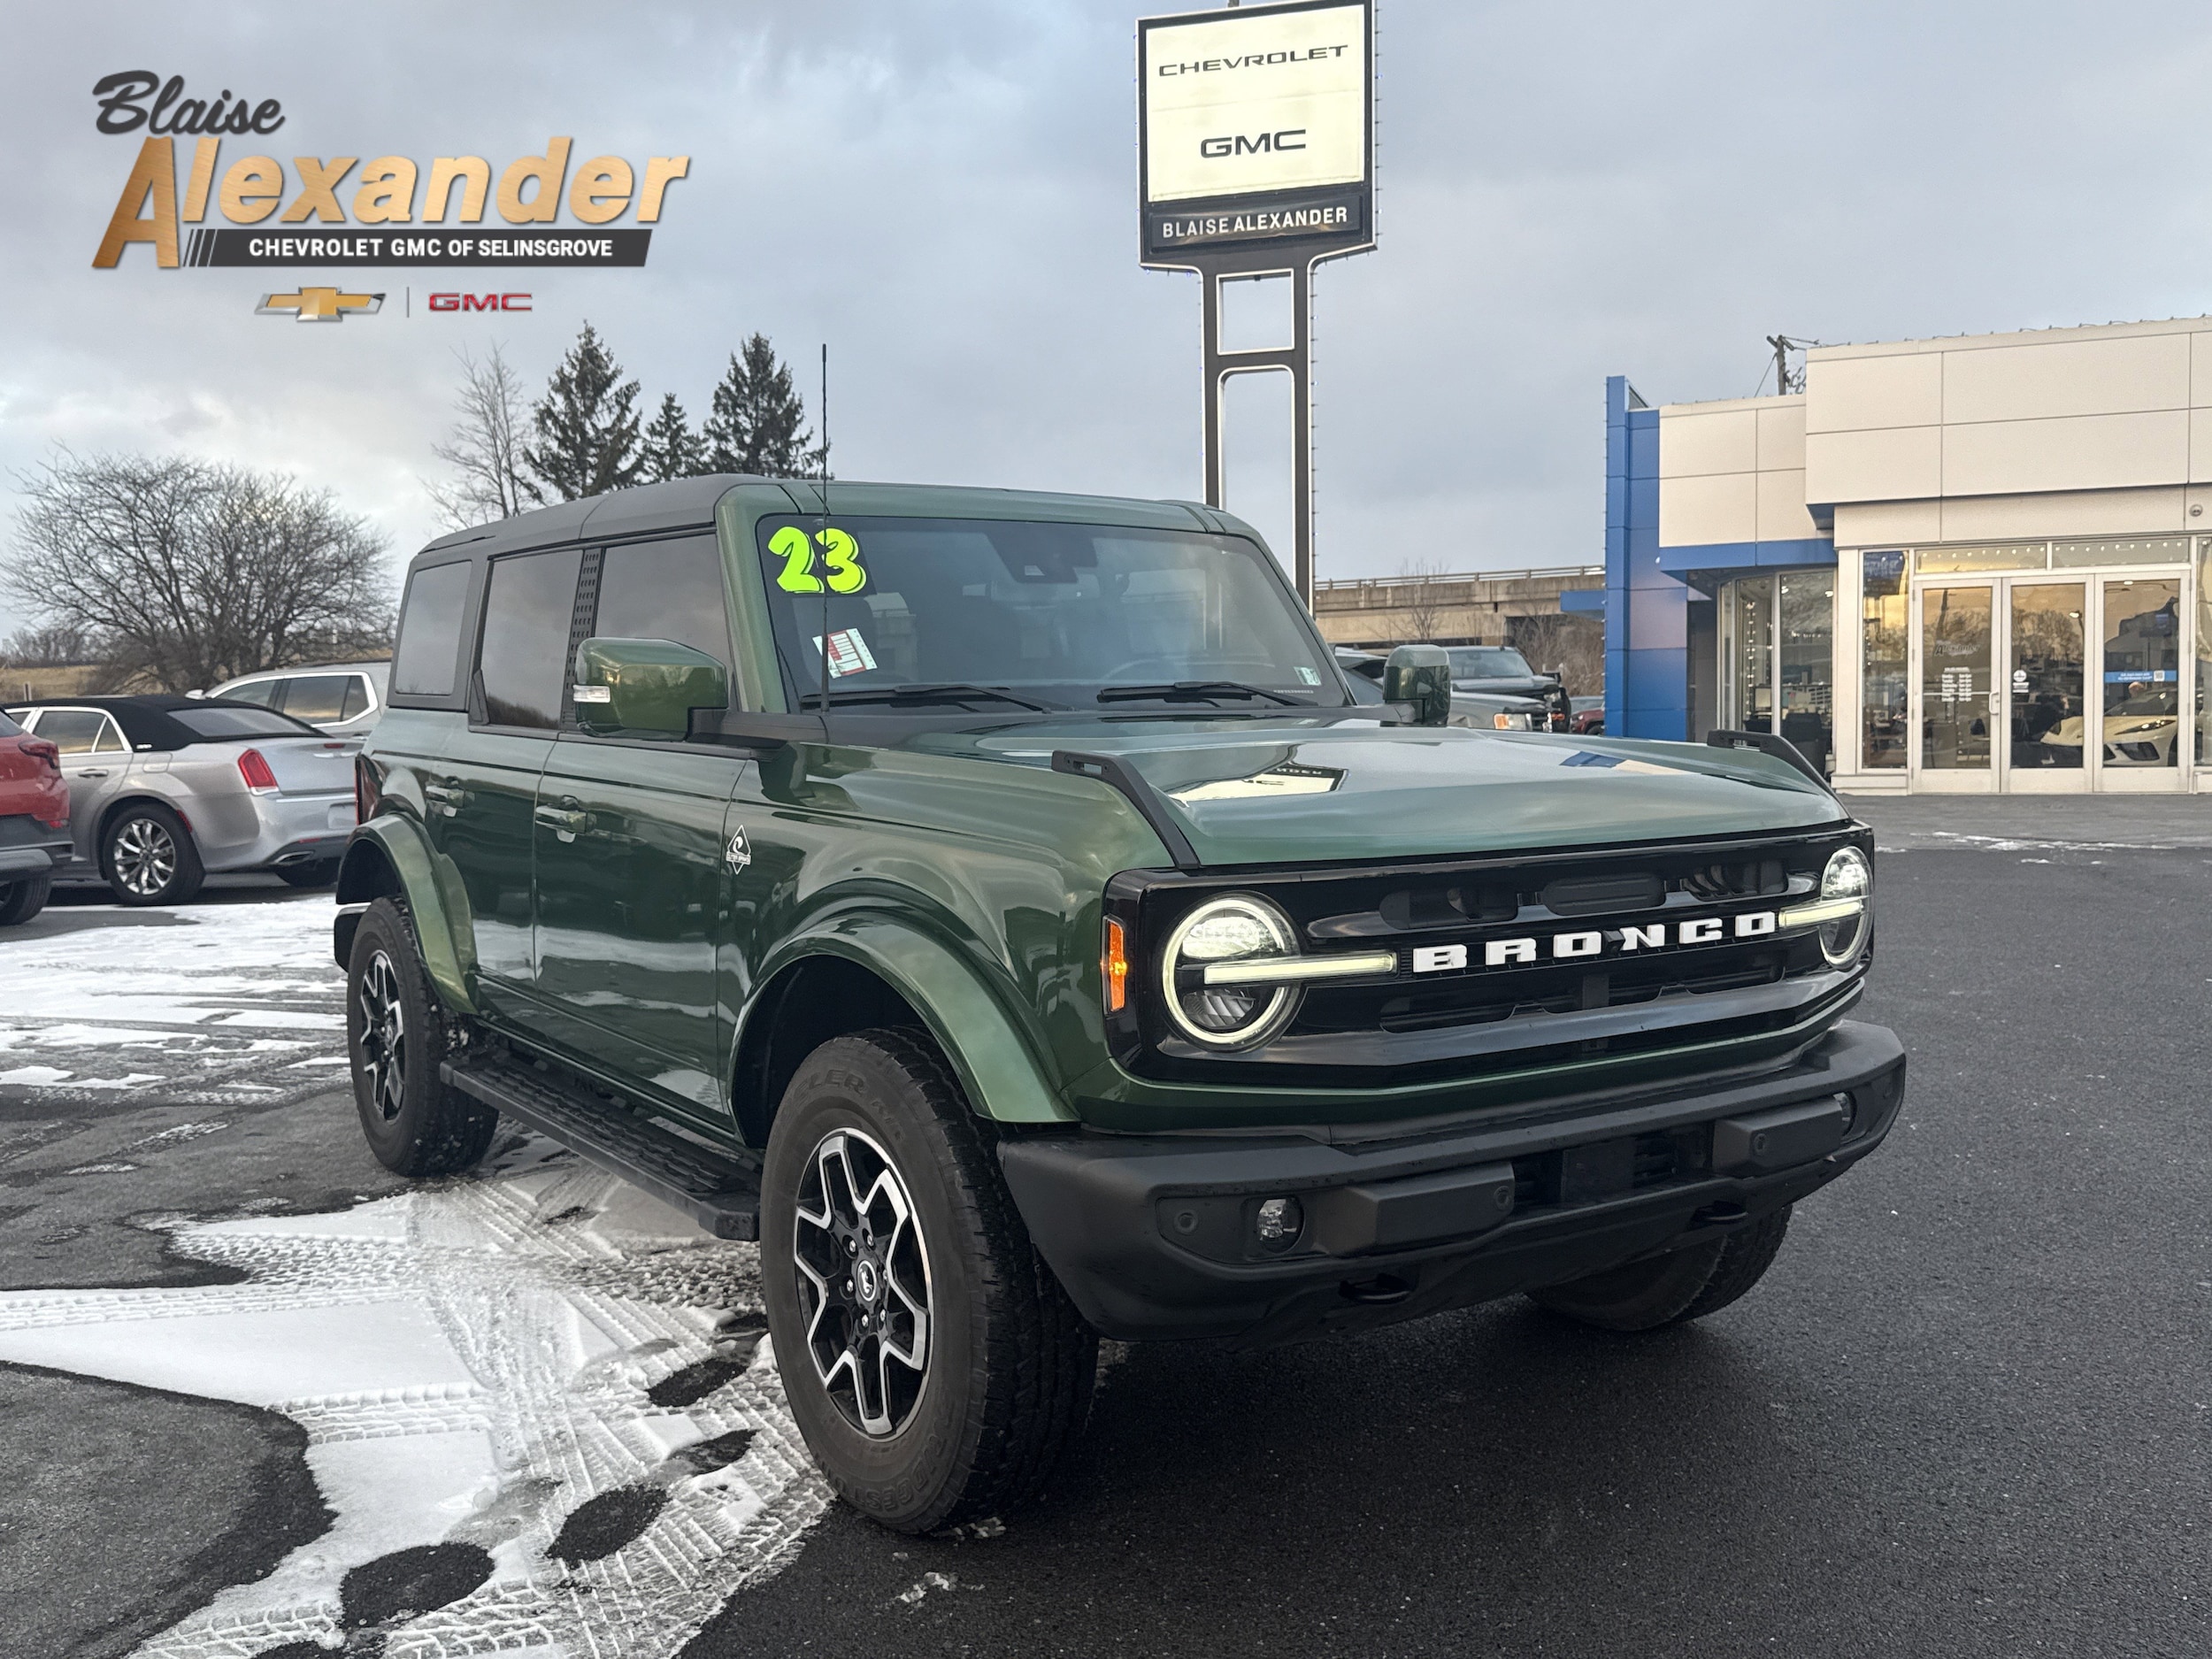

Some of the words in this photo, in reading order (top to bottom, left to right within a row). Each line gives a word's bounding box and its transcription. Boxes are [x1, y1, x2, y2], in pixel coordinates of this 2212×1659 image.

[1160, 45, 1348, 76] CHEVROLET
[1201, 129, 1306, 158] GMC
[1163, 218, 1229, 238] BLAISE
[1233, 207, 1348, 232] ALEXANDER
[768, 526, 866, 594] 23
[1413, 911, 1775, 972] BRONCO
